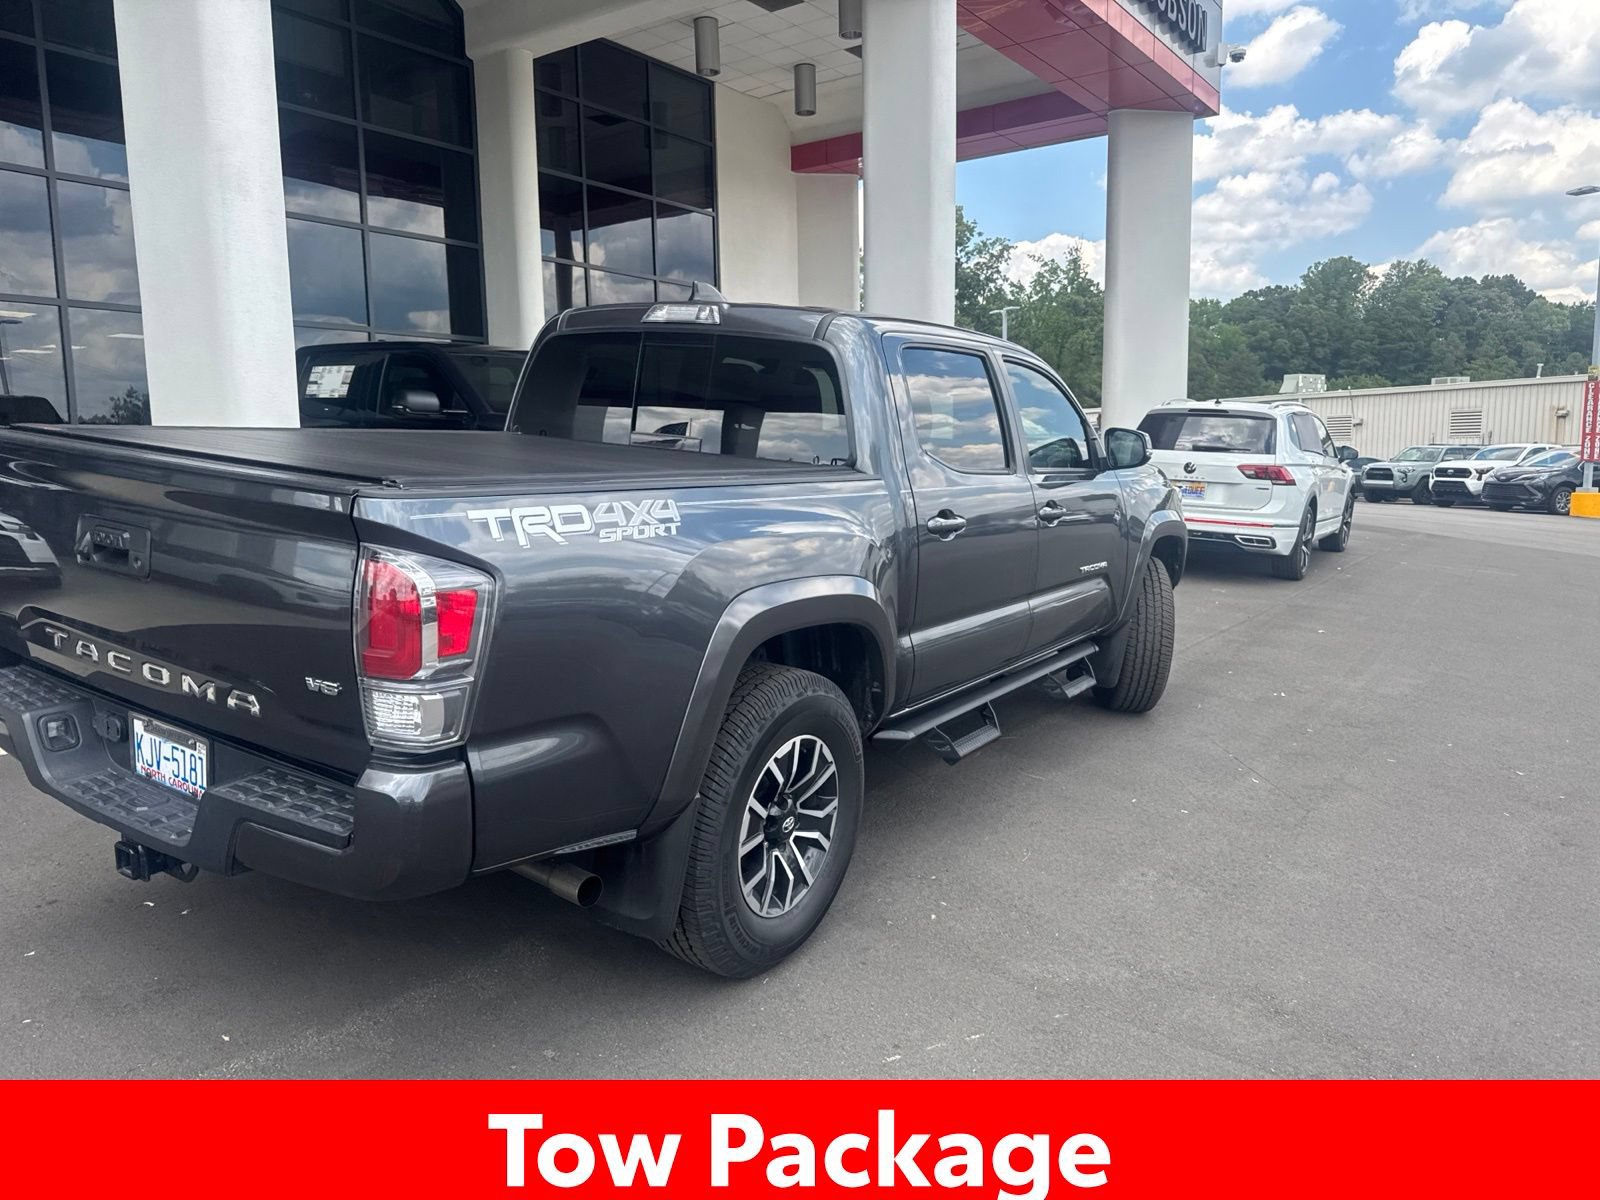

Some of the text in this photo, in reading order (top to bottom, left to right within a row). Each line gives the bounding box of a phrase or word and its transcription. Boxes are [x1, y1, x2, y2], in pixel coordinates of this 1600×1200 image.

[1583, 436, 1591, 459] ZONE
[466, 504, 596, 548] TRD
[599, 522, 682, 543] SPORT
[45, 627, 261, 717] TACOMA
[304, 676, 343, 696] V6
[136, 731, 206, 790] KJV-5181
[140, 765, 166, 783] NORTH
